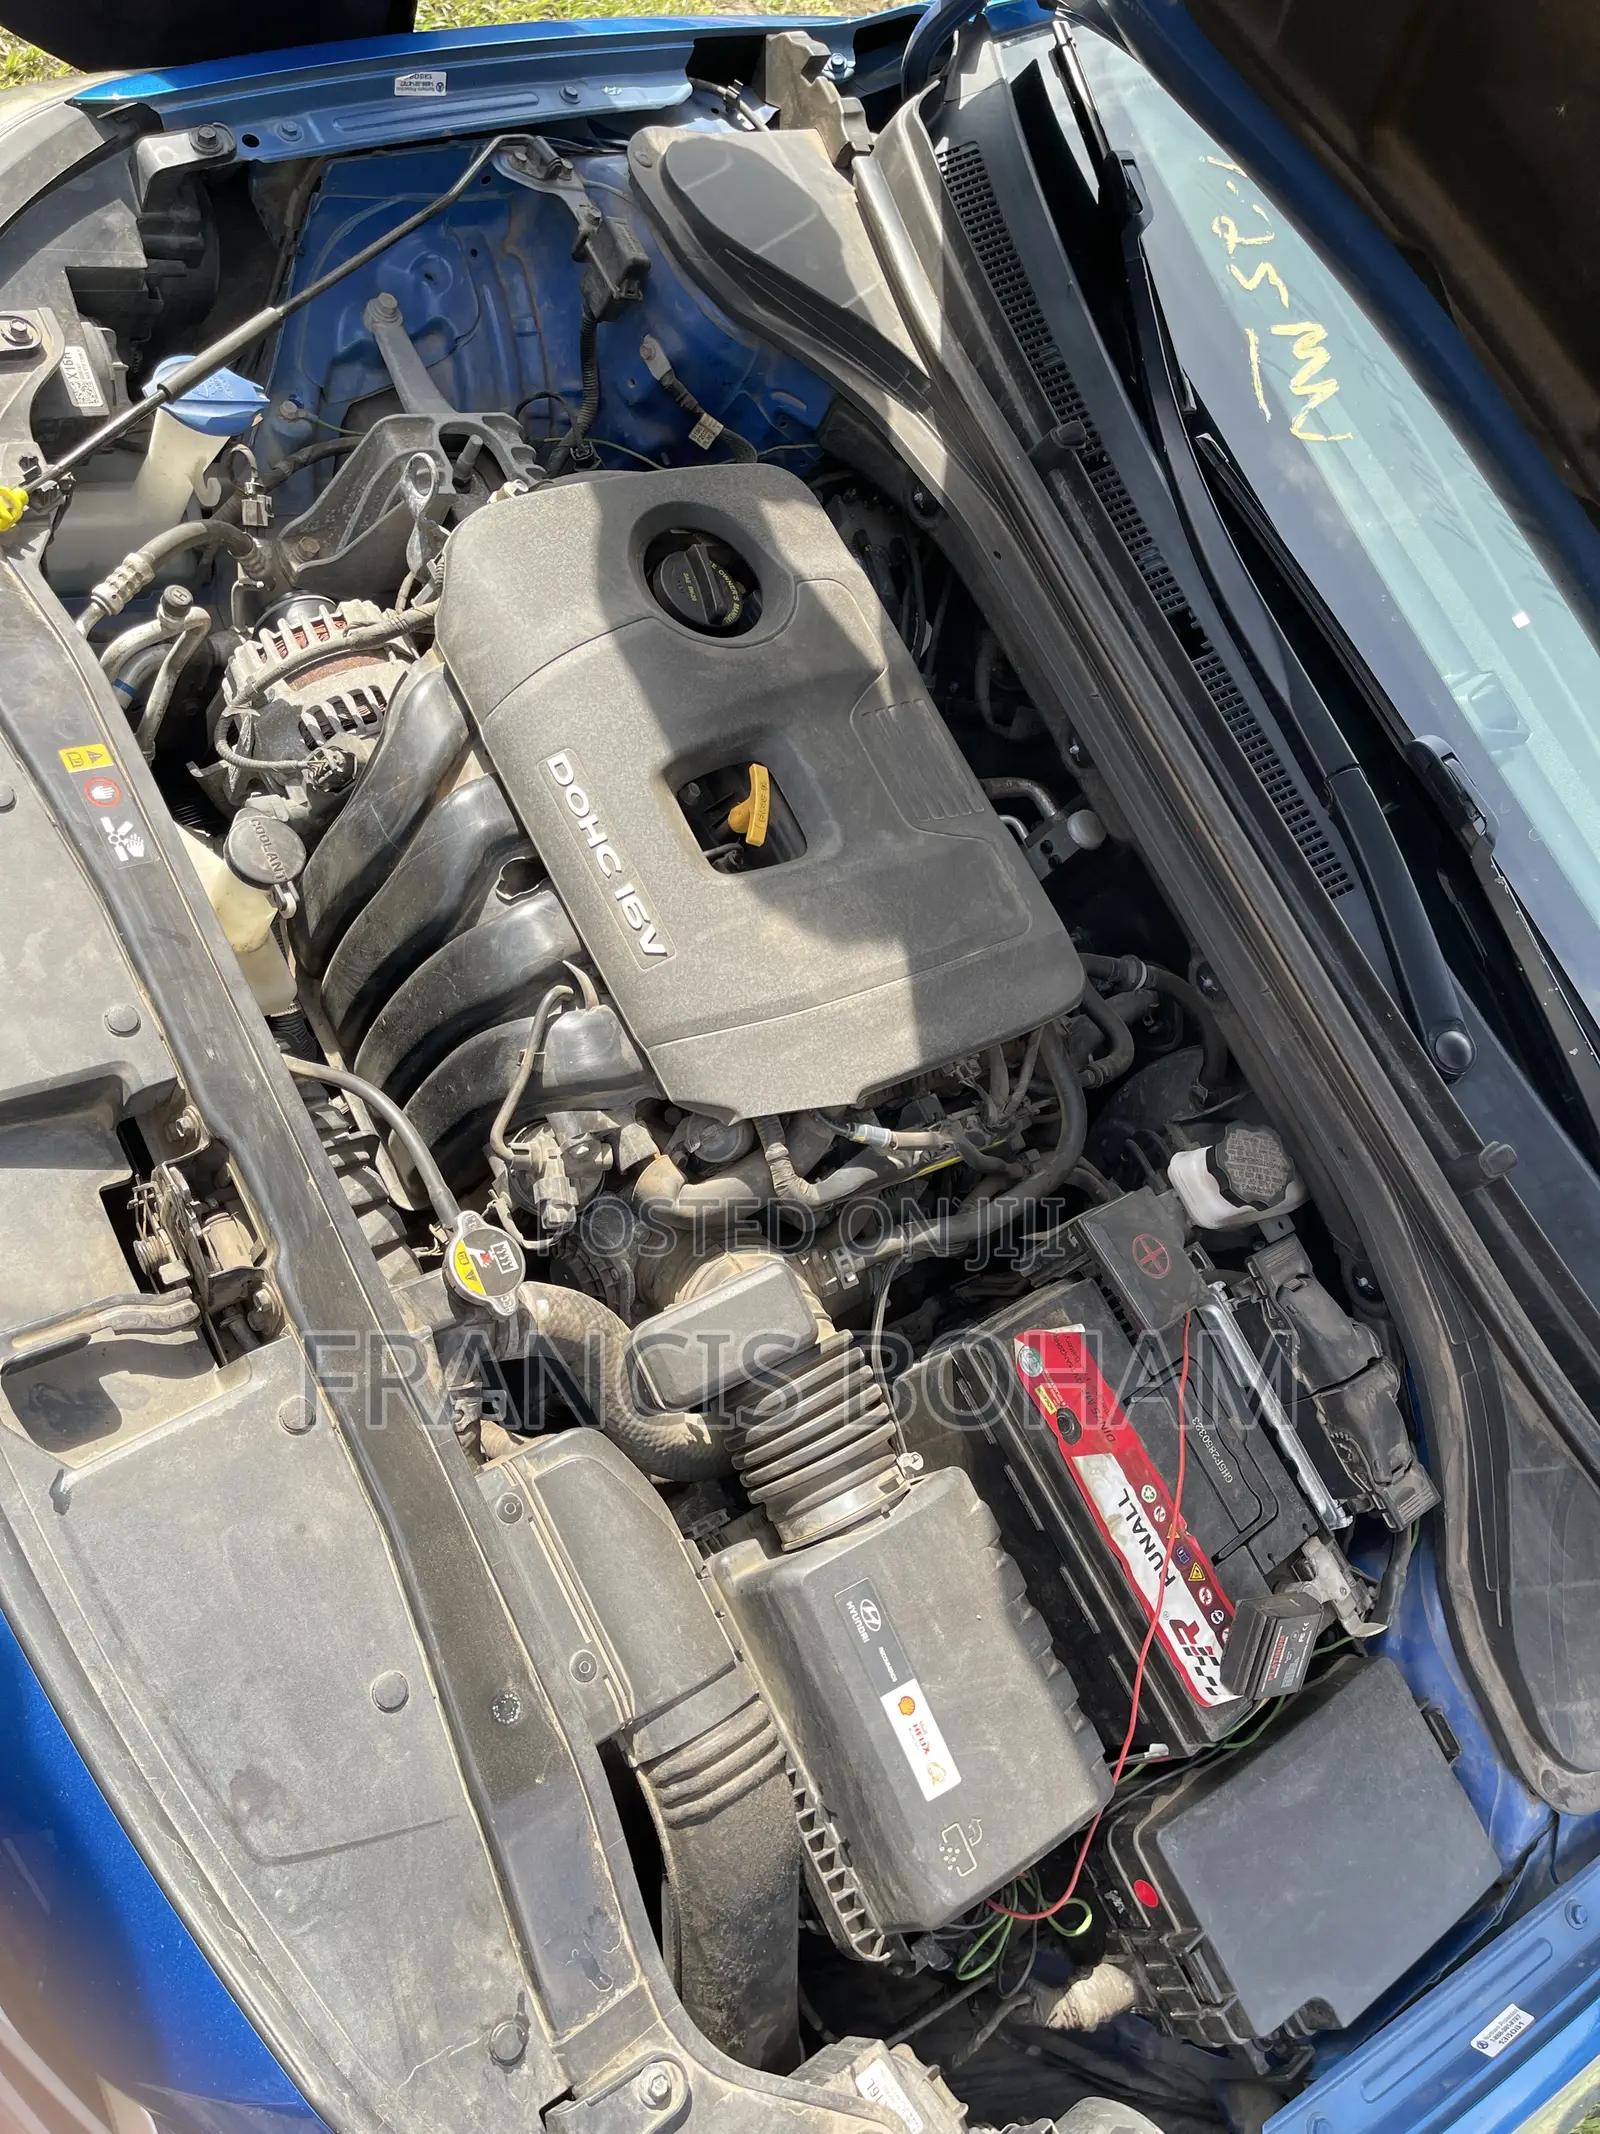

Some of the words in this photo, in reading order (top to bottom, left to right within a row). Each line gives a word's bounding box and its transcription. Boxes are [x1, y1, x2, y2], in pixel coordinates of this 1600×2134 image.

[250, 819, 287, 880] COOLANT
[546, 753, 622, 878] DOHC
[613, 883, 668, 957] 16V
[1118, 1488, 1176, 1588] RUNALL
[846, 1601, 870, 1643] HYUNDAI
[1267, 1635, 1286, 1681] PLATINUM
[912, 1723, 931, 1756] HELIX
